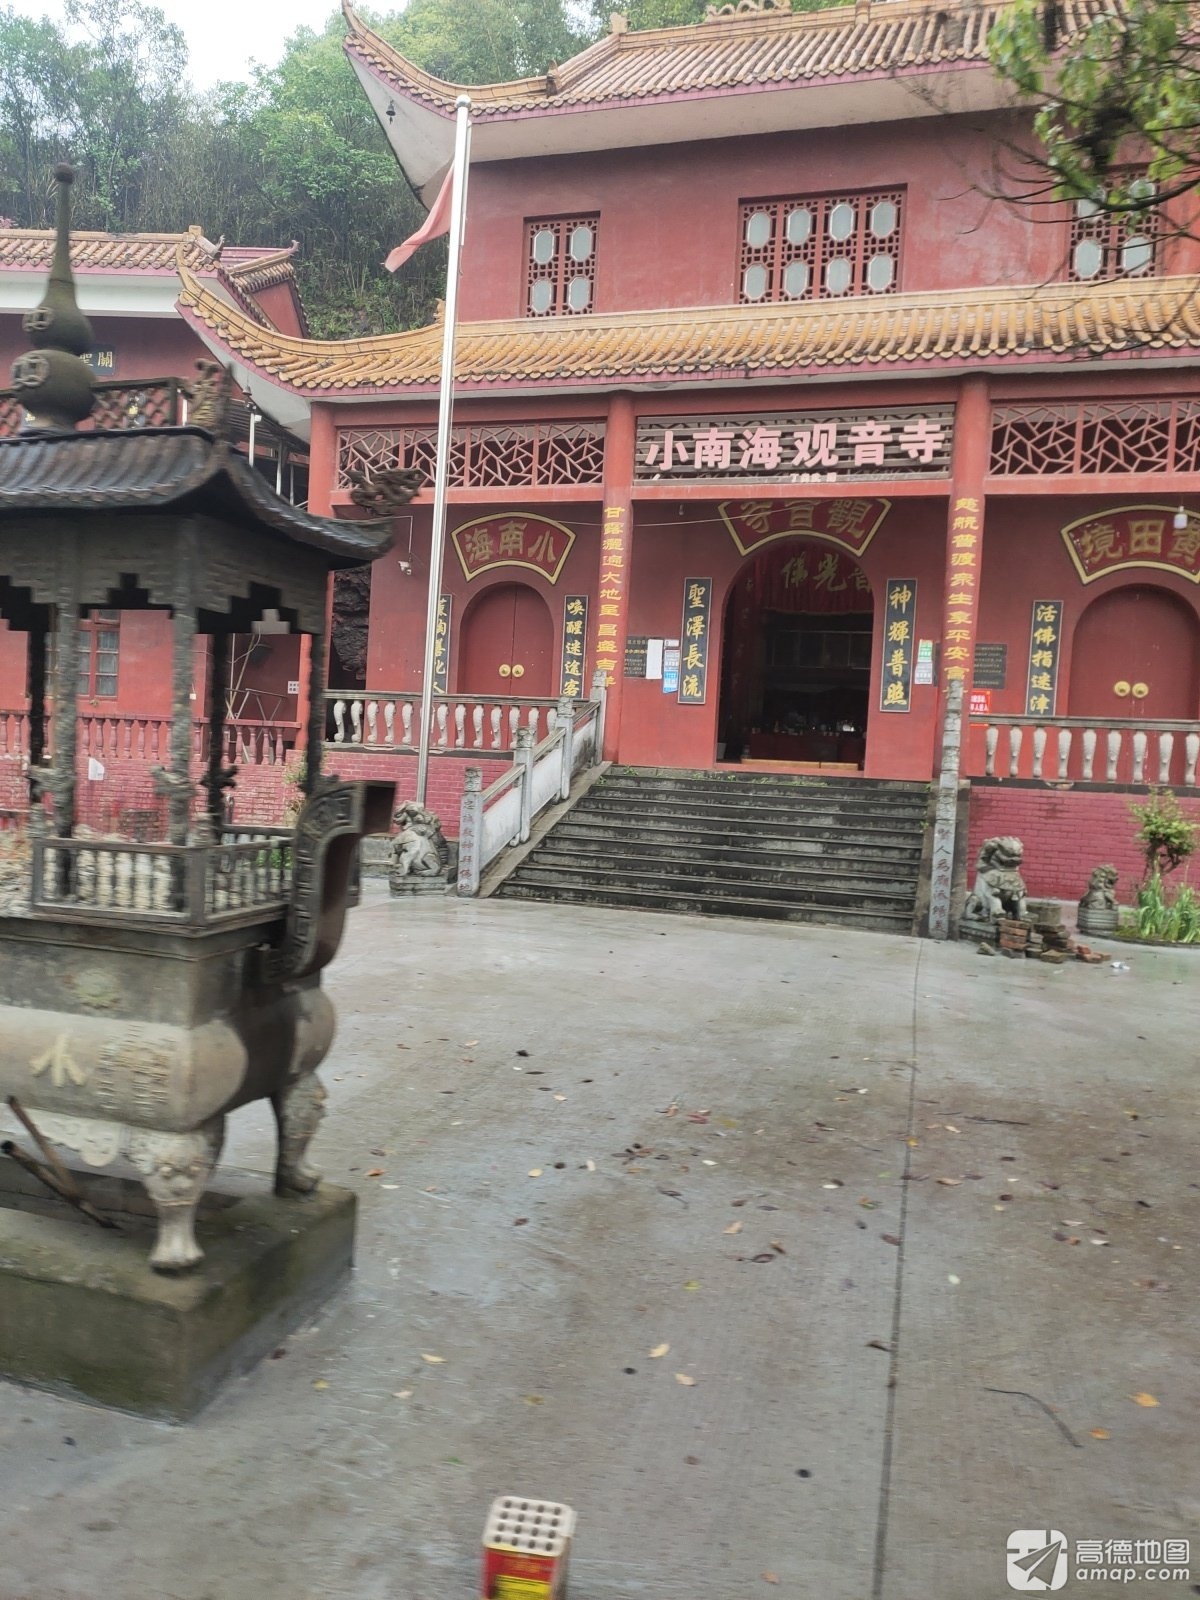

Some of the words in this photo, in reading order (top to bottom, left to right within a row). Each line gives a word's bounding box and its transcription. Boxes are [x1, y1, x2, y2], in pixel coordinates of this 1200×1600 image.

[645, 419, 946, 471] 小南海观音寺
[464, 520, 557, 564] 小南海
[562, 598, 586, 697] 喚醒迷途客
[682, 584, 707, 697] 聖澤長流
[883, 584, 912, 706] 神輝普照
[1029, 604, 1058, 714] 活佛指迷津
